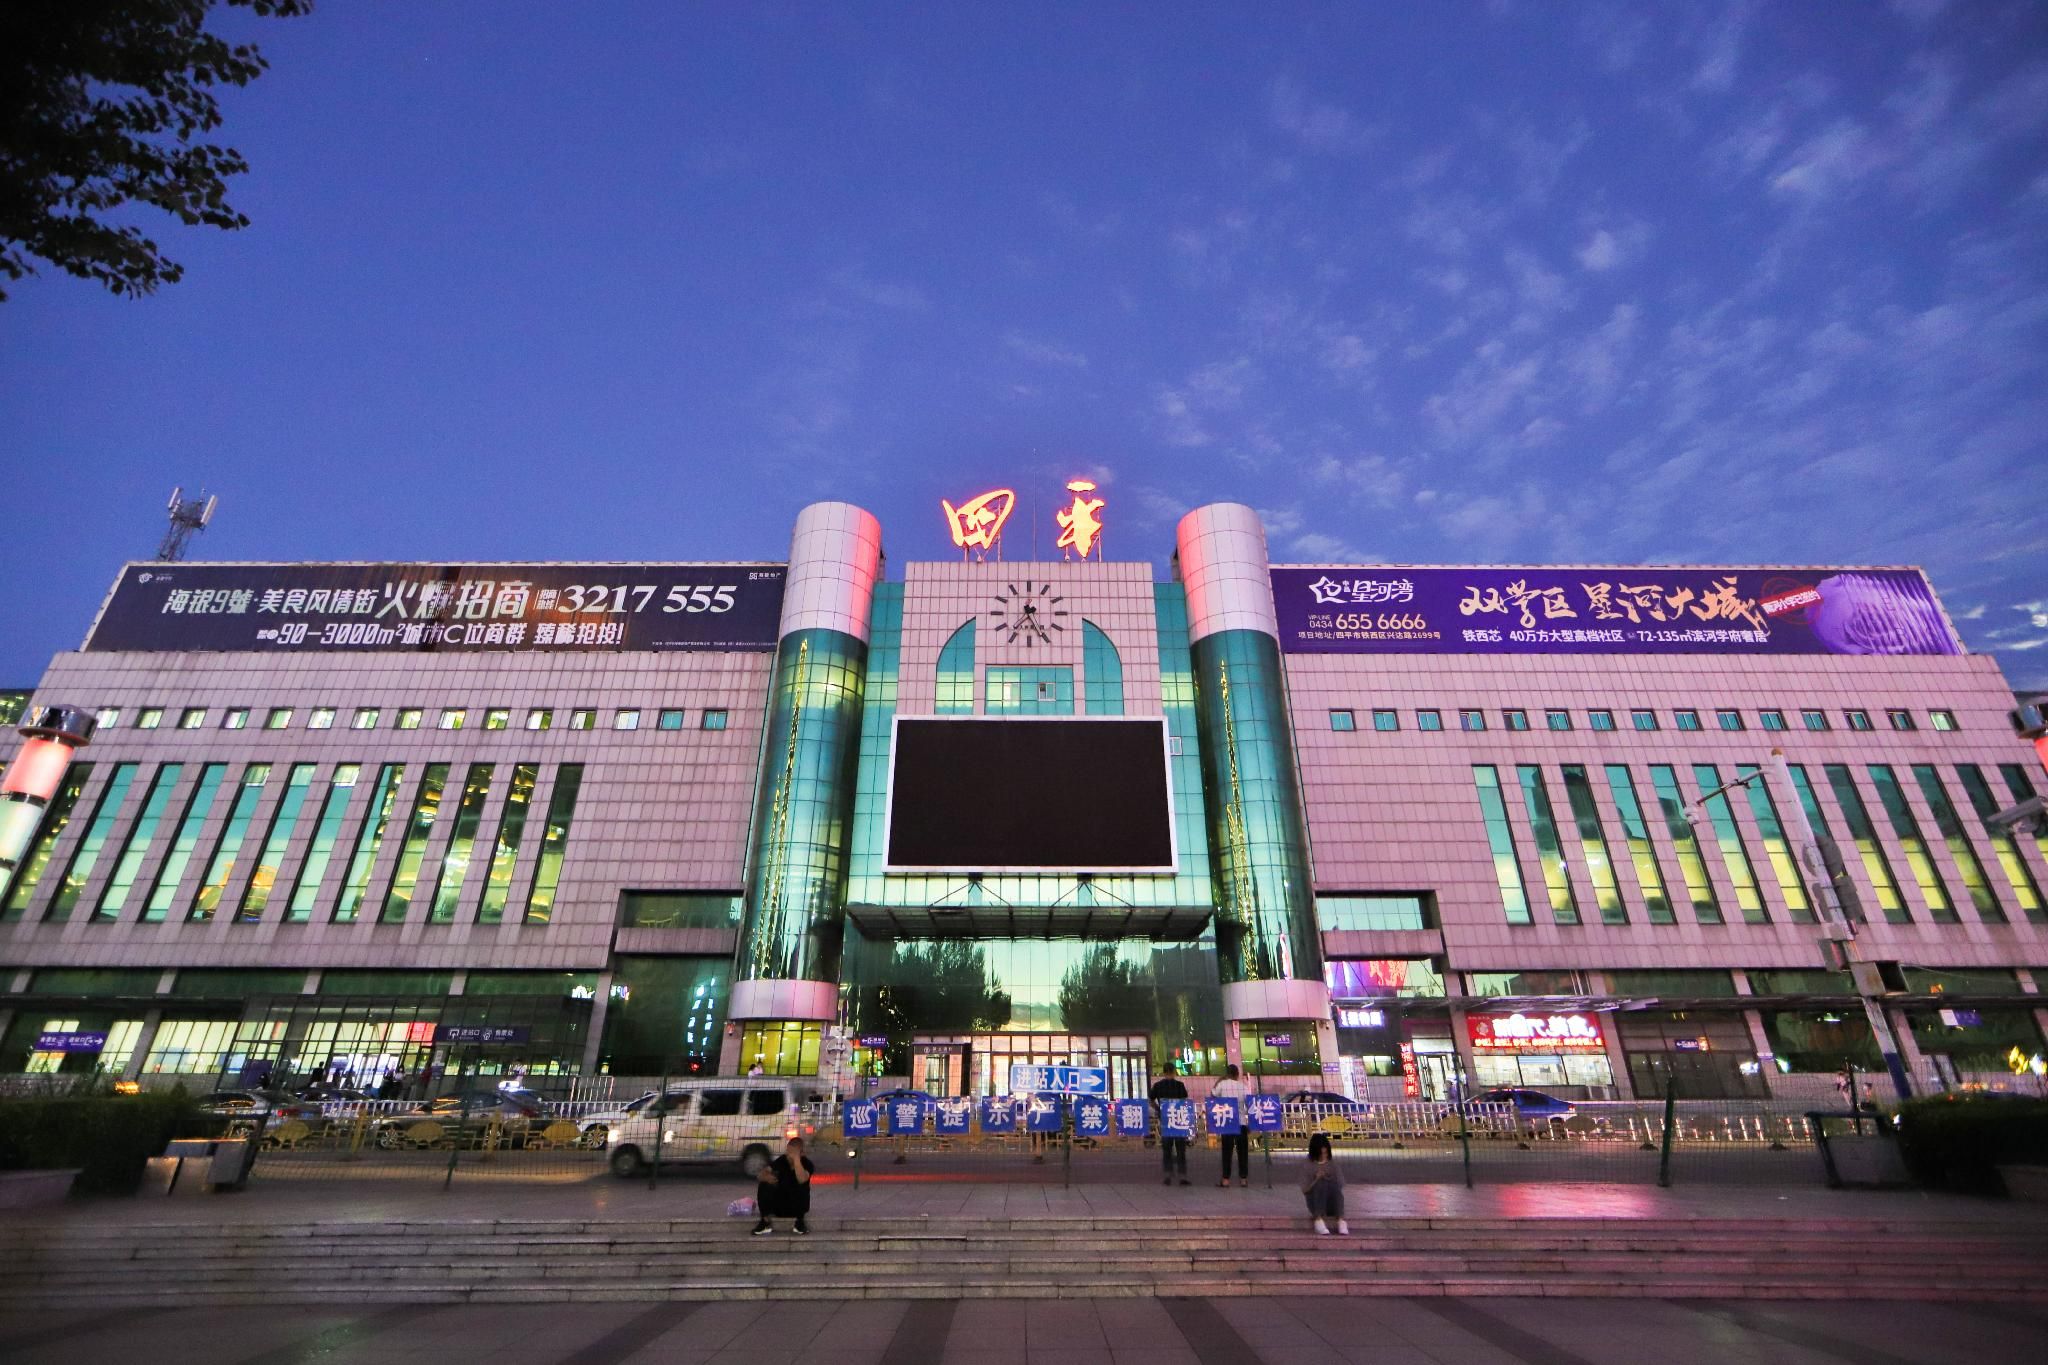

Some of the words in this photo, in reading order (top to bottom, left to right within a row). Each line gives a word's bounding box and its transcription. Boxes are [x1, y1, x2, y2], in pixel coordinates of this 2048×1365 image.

[558, 585, 658, 613] 3217
[662, 585, 738, 613] 555
[1351, 579, 1414, 603] 星河湾
[1309, 620, 1333, 629] 0434
[1335, 613, 1373, 630] 655
[1377, 613, 1426, 630] 6666
[1462, 629, 1503, 642] 铁西芯
[1509, 629, 1626, 643] 40万方大型高档社区
[1016, 1069, 1080, 1089] 进站入口
